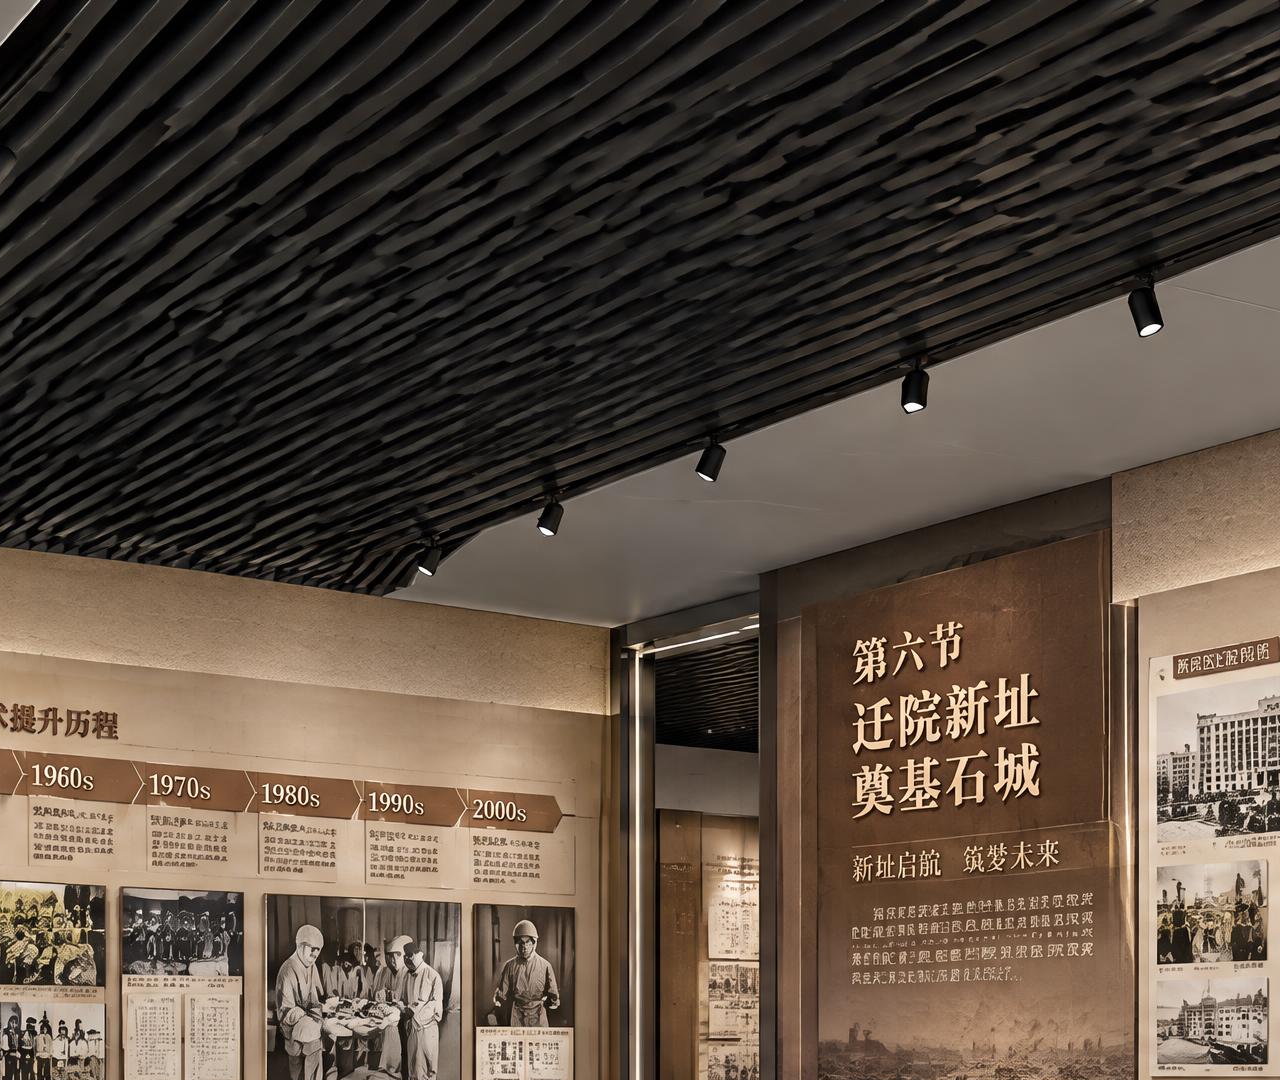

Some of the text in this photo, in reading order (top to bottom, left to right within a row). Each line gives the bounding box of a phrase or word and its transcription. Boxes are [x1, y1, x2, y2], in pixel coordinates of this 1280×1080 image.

[852, 620, 965, 686] 第六节
[852, 673, 1041, 755] 迁院新址
[31, 764, 94, 791] 1960s
[149, 774, 211, 800] 1970s
[261, 783, 320, 808] 1980s
[368, 791, 424, 816] 1990s
[472, 799, 527, 822] 2000s
[851, 743, 1041, 820] 奠基石城
